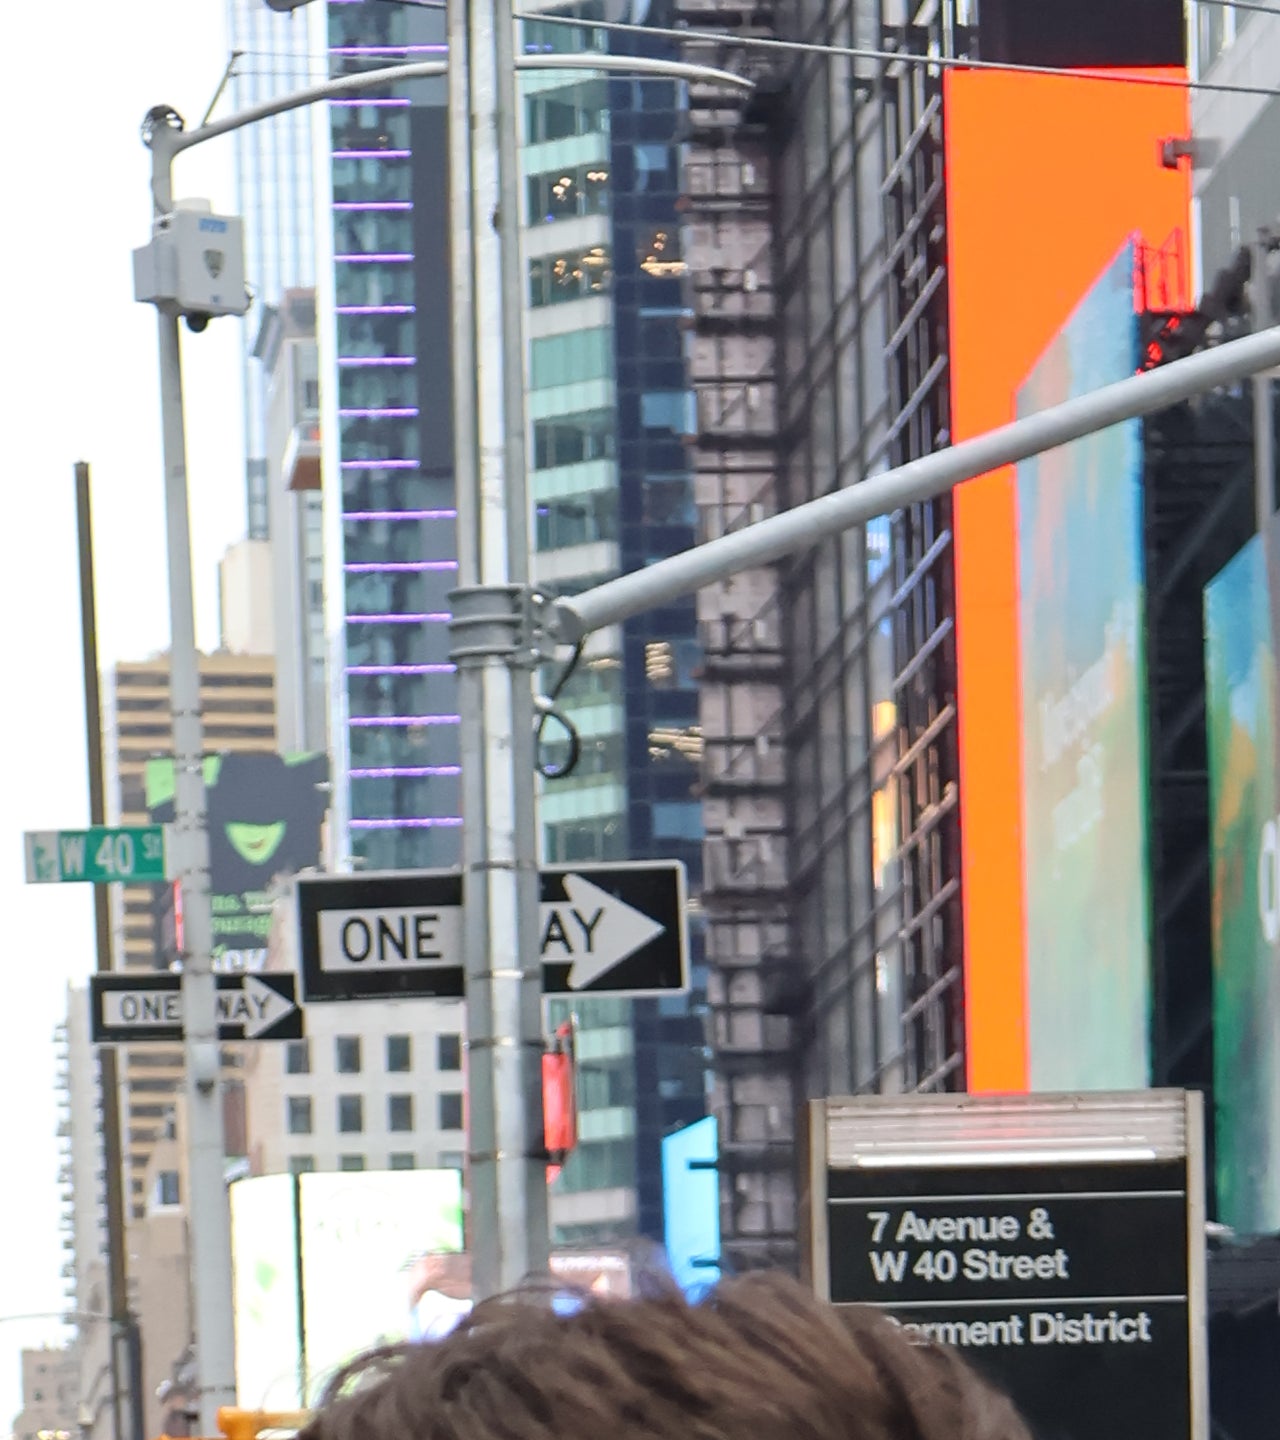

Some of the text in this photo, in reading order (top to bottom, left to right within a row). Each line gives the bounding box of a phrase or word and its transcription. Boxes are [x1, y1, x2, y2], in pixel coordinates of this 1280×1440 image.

[60, 836, 85, 875] W
[95, 834, 135, 875] 40
[342, 908, 605, 963] ONE AY
[120, 995, 181, 1021] ONE
[867, 1208, 1055, 1243] 7 Avenue &
[868, 1248, 1069, 1282] W 40 Street
[1030, 1311, 1152, 1344] District
